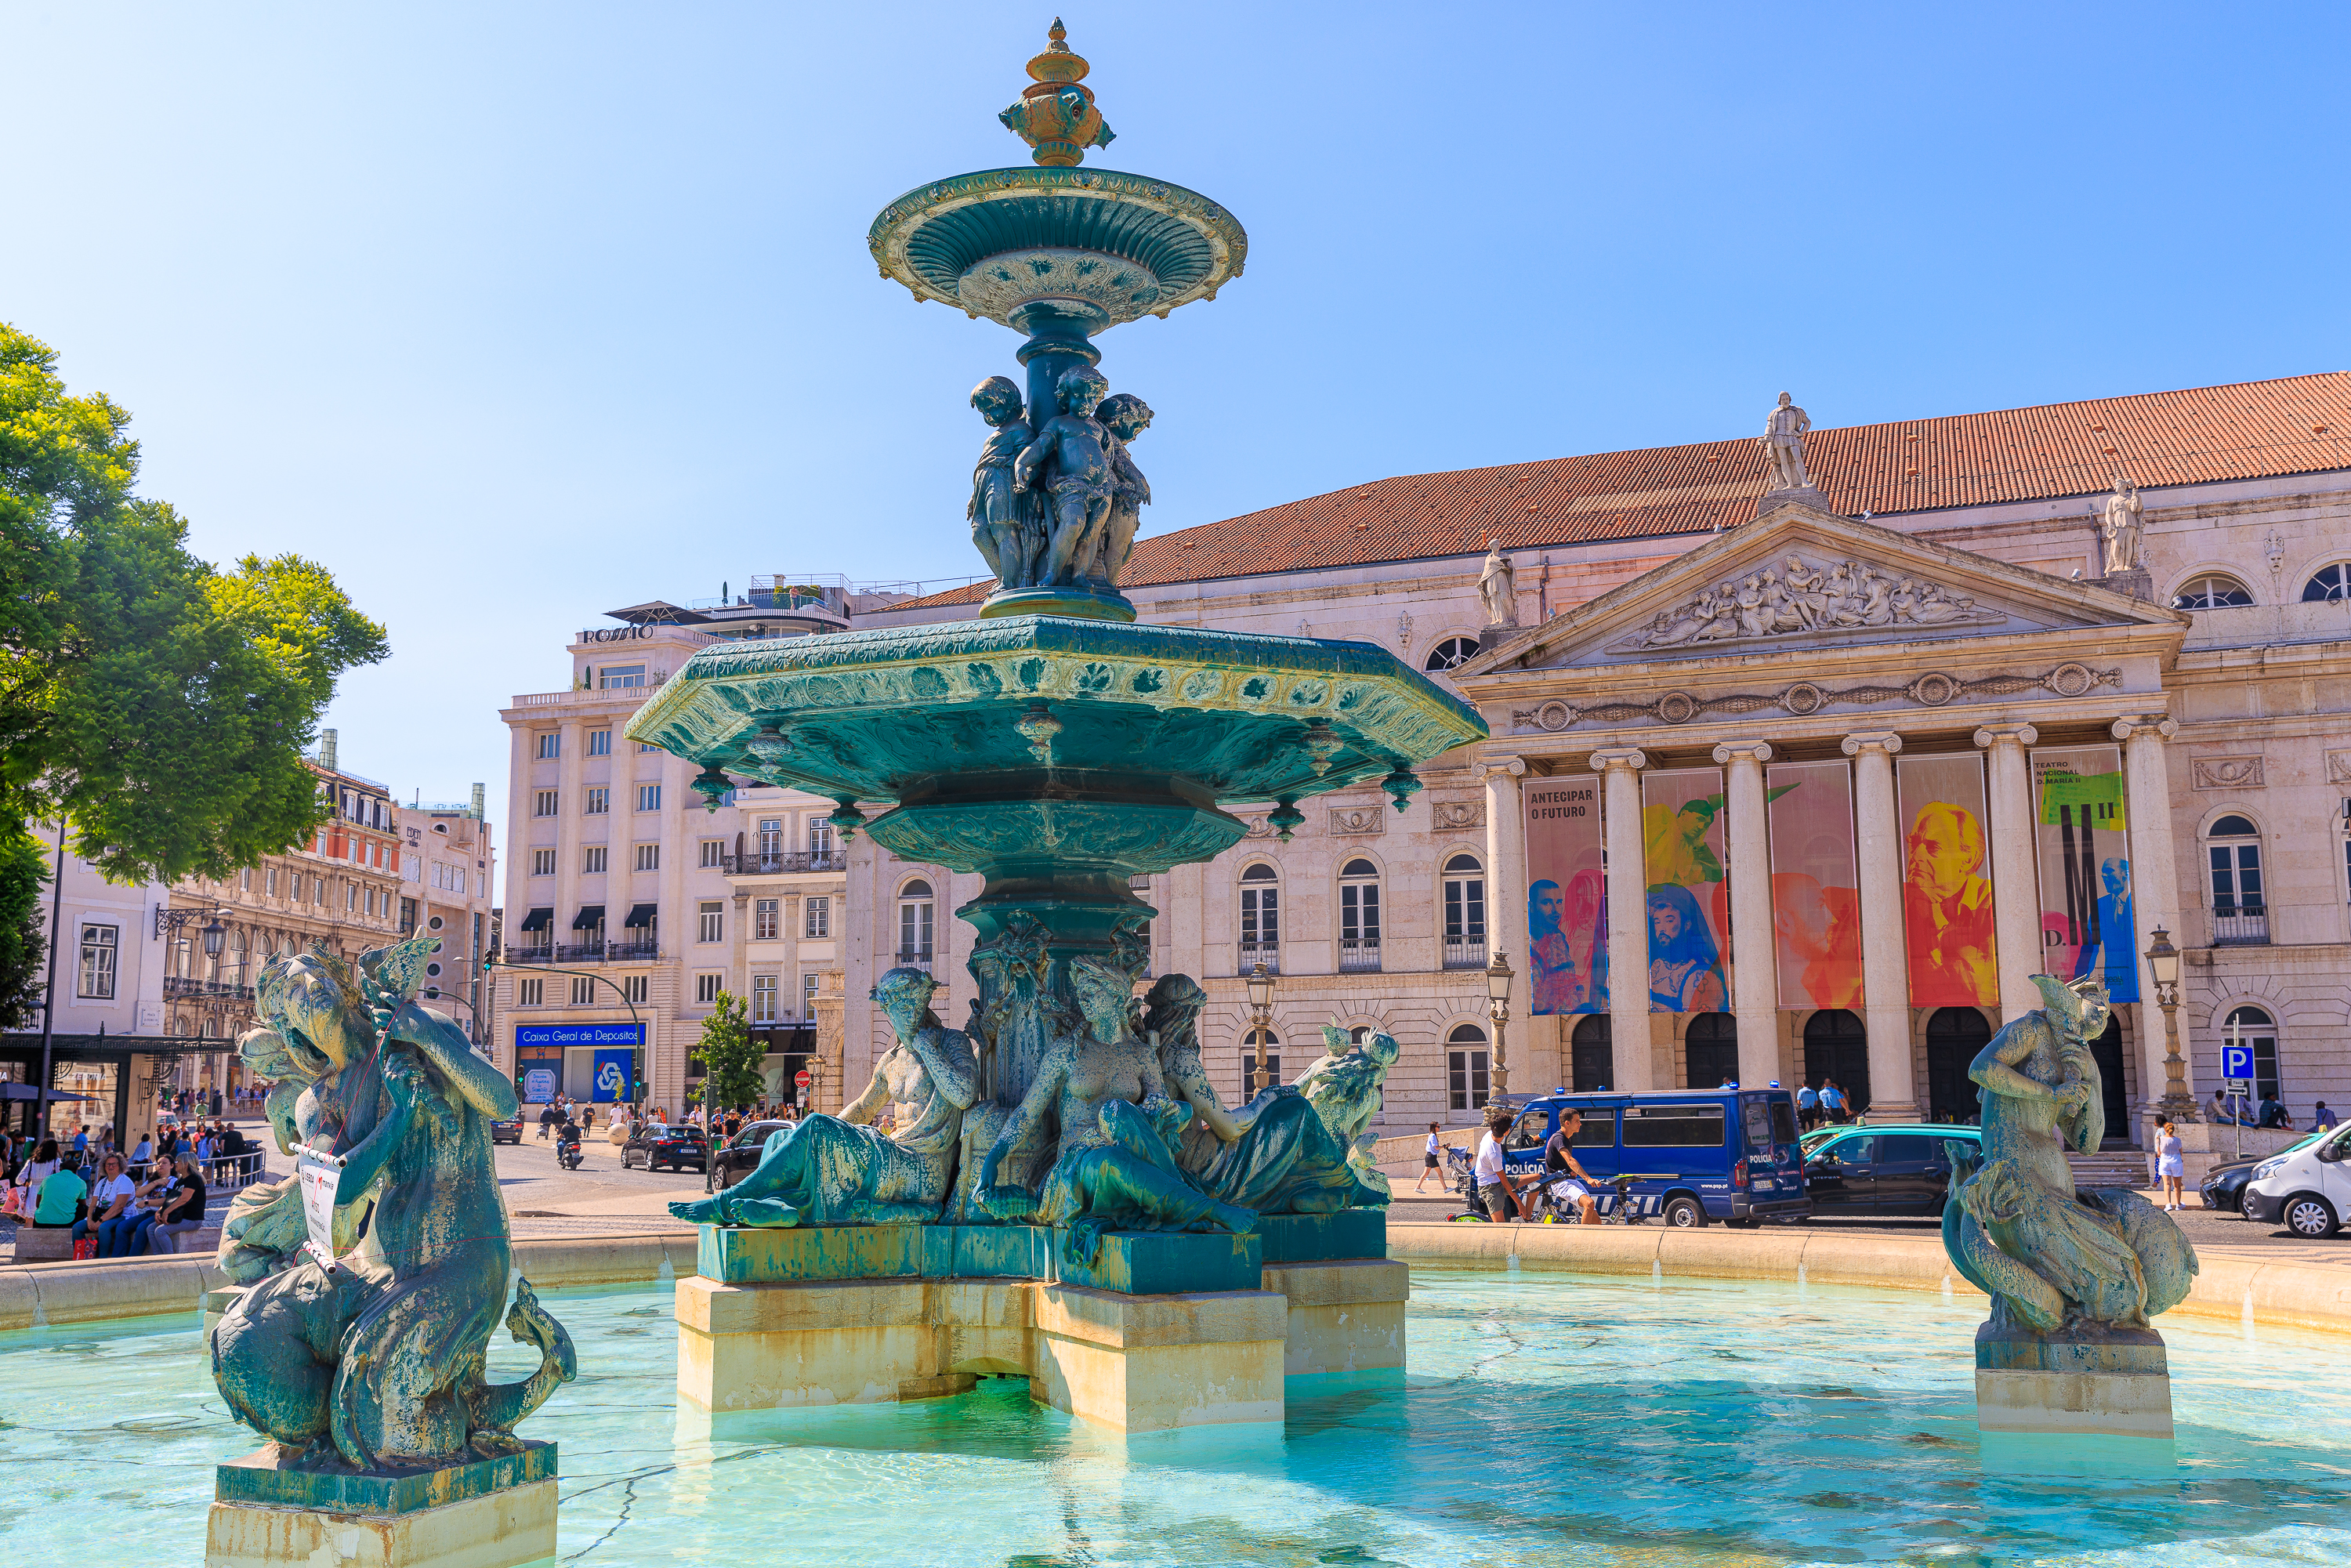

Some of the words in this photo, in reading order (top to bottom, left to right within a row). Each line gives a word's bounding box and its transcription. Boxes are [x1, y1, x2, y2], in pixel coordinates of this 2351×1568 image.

[583, 625, 654, 643] ROSSIO
[1531, 790, 1592, 804] ANTECIPAR
[1531, 809, 1539, 820] O
[1541, 806, 1585, 819] FUTURO
[2097, 802, 2115, 820] II
[407, 826, 422, 840] EDEN
[2060, 803, 2102, 946] M
[2045, 929, 2067, 947] D.
[523, 1030, 549, 1042] Caixa
[552, 1030, 578, 1041] Geral
[580, 1031, 592, 1041] de
[2229, 1049, 2247, 1075] P
[1749, 1153, 1773, 1164] POLÍCIA
[1505, 1161, 1545, 1175] POLÍCIA
